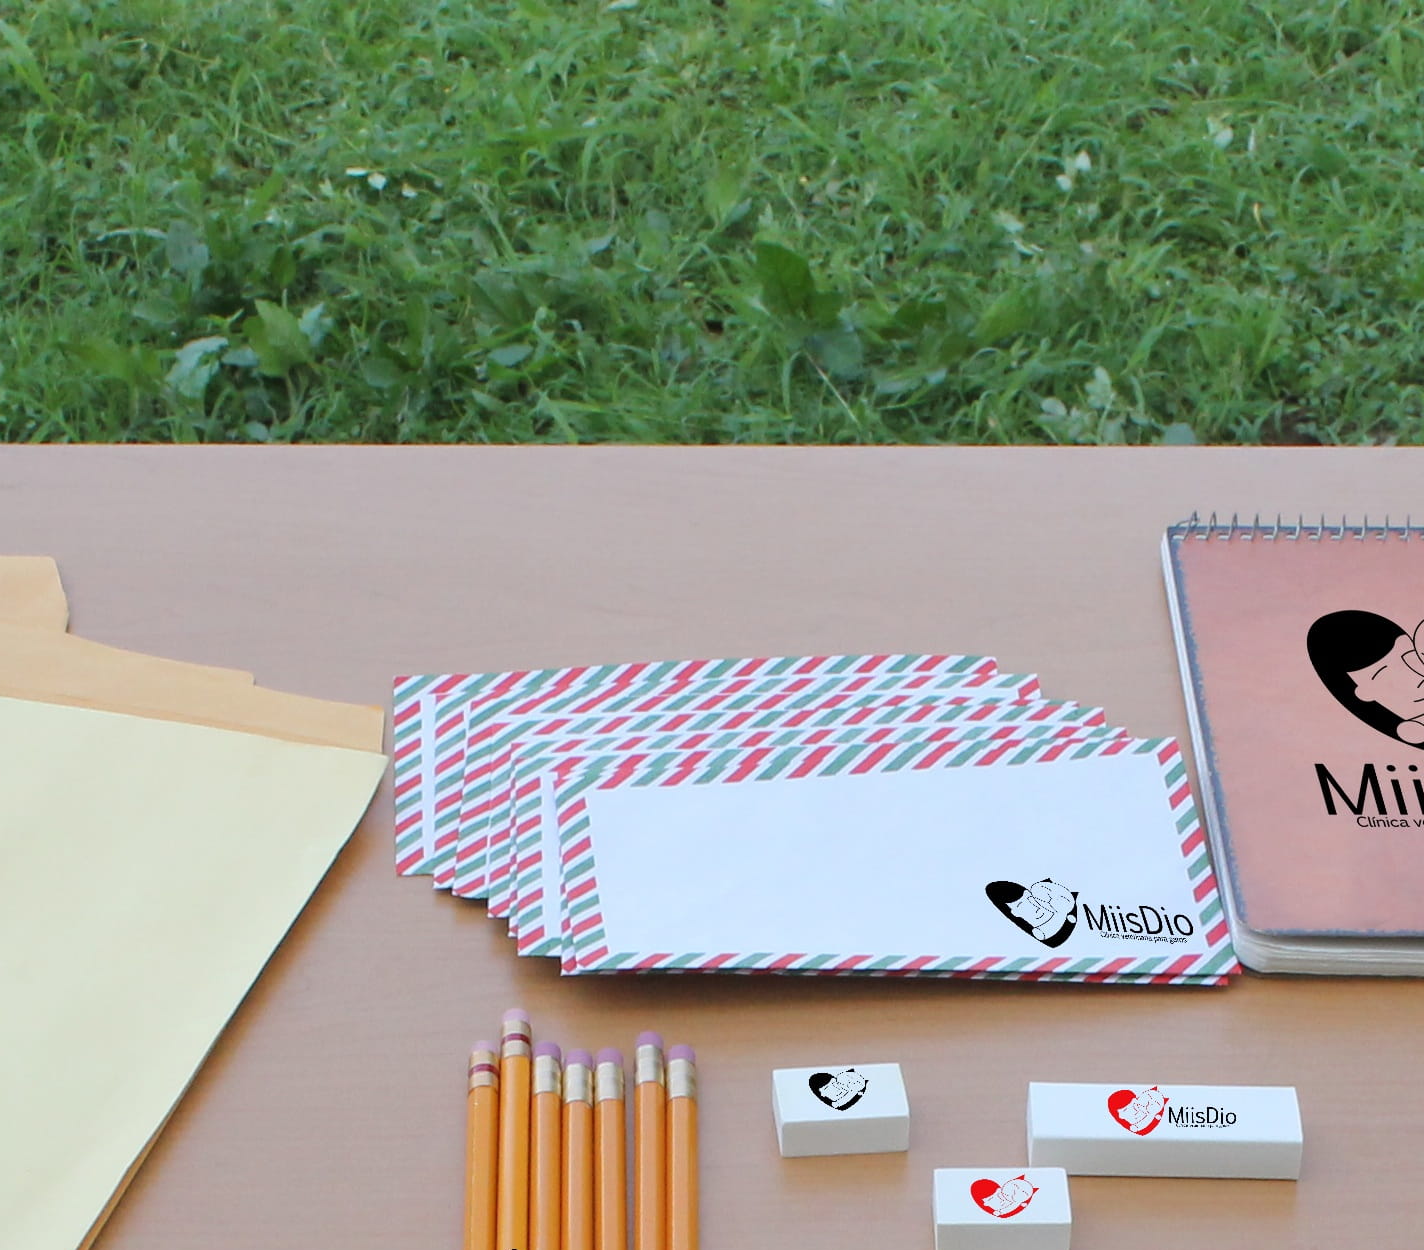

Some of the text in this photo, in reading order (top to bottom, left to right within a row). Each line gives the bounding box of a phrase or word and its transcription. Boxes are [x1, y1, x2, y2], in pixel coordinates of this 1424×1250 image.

[1356, 815, 1410, 828] Clínica
[1082, 903, 1194, 936] MiisDio
[1168, 1106, 1237, 1124] MiisDio
